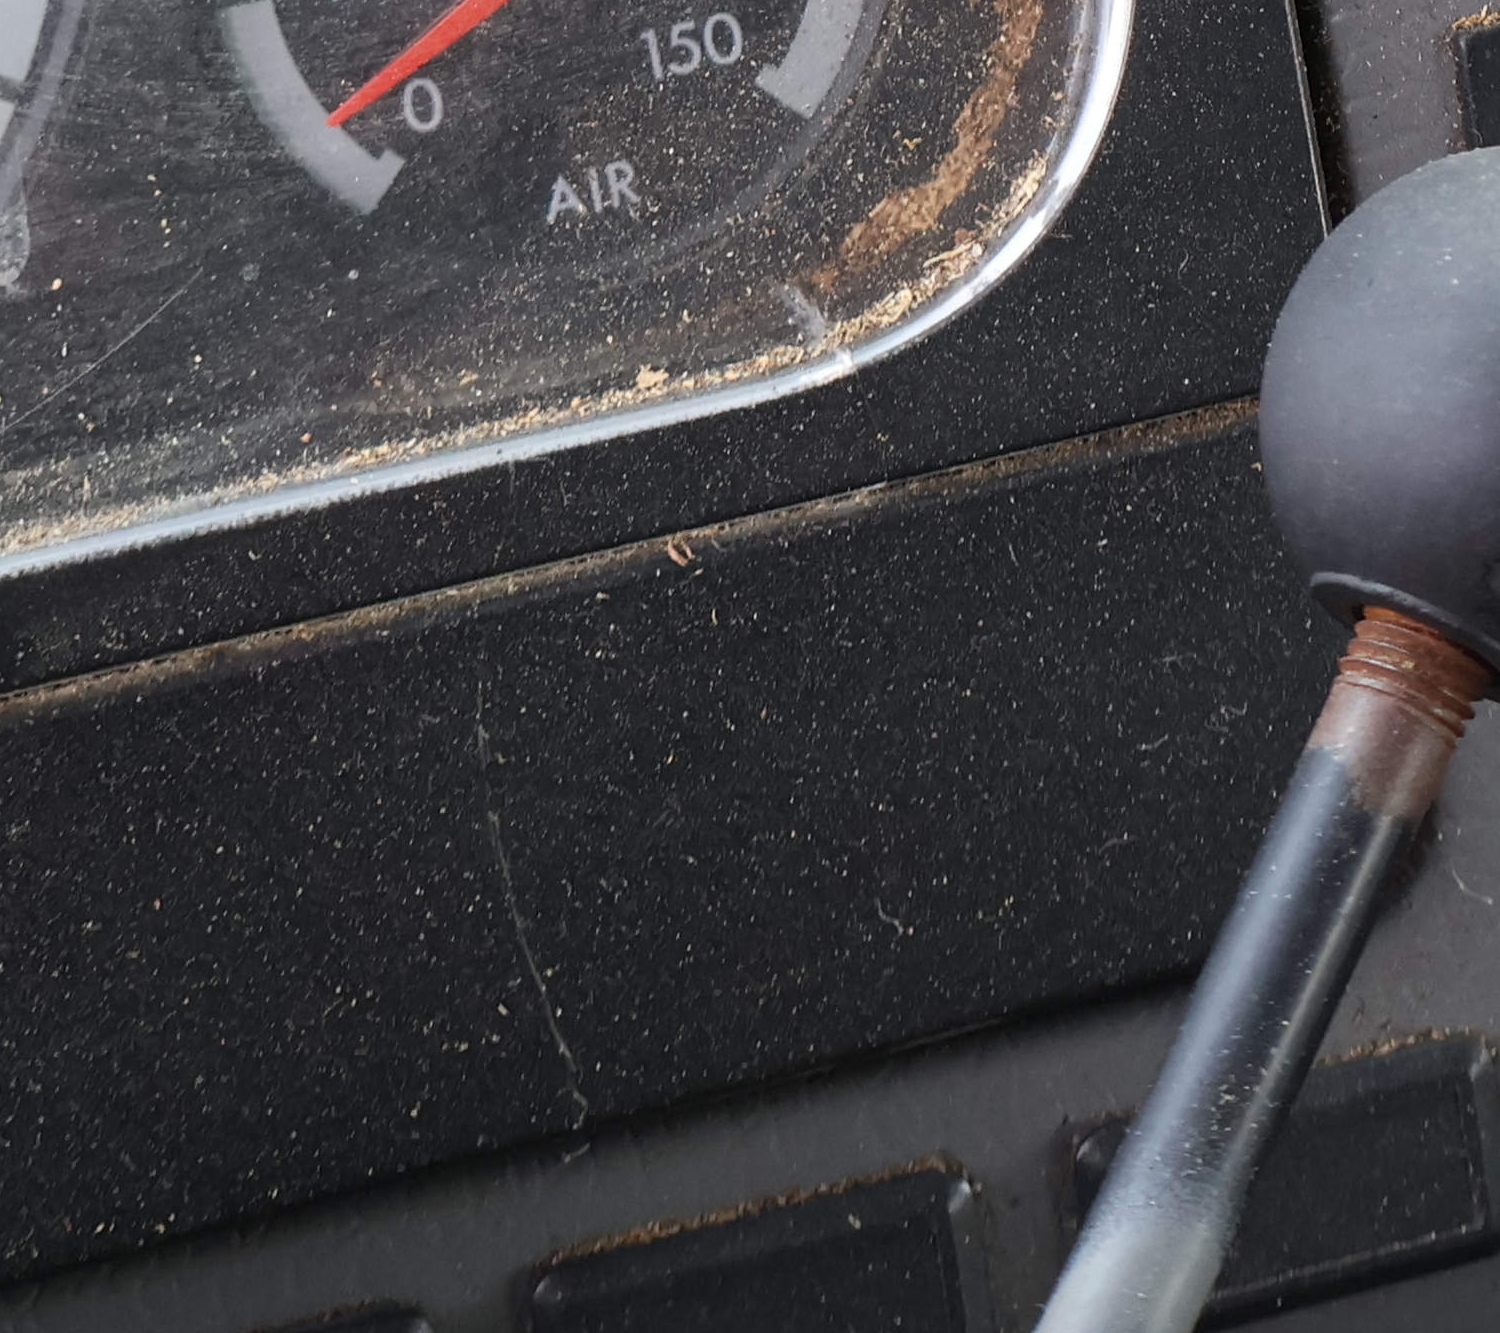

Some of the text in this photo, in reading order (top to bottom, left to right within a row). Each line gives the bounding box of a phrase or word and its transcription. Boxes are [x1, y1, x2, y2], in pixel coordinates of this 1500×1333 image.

[640, 12, 743, 81] 150
[403, 78, 442, 131] 0
[548, 160, 641, 224] AIR
